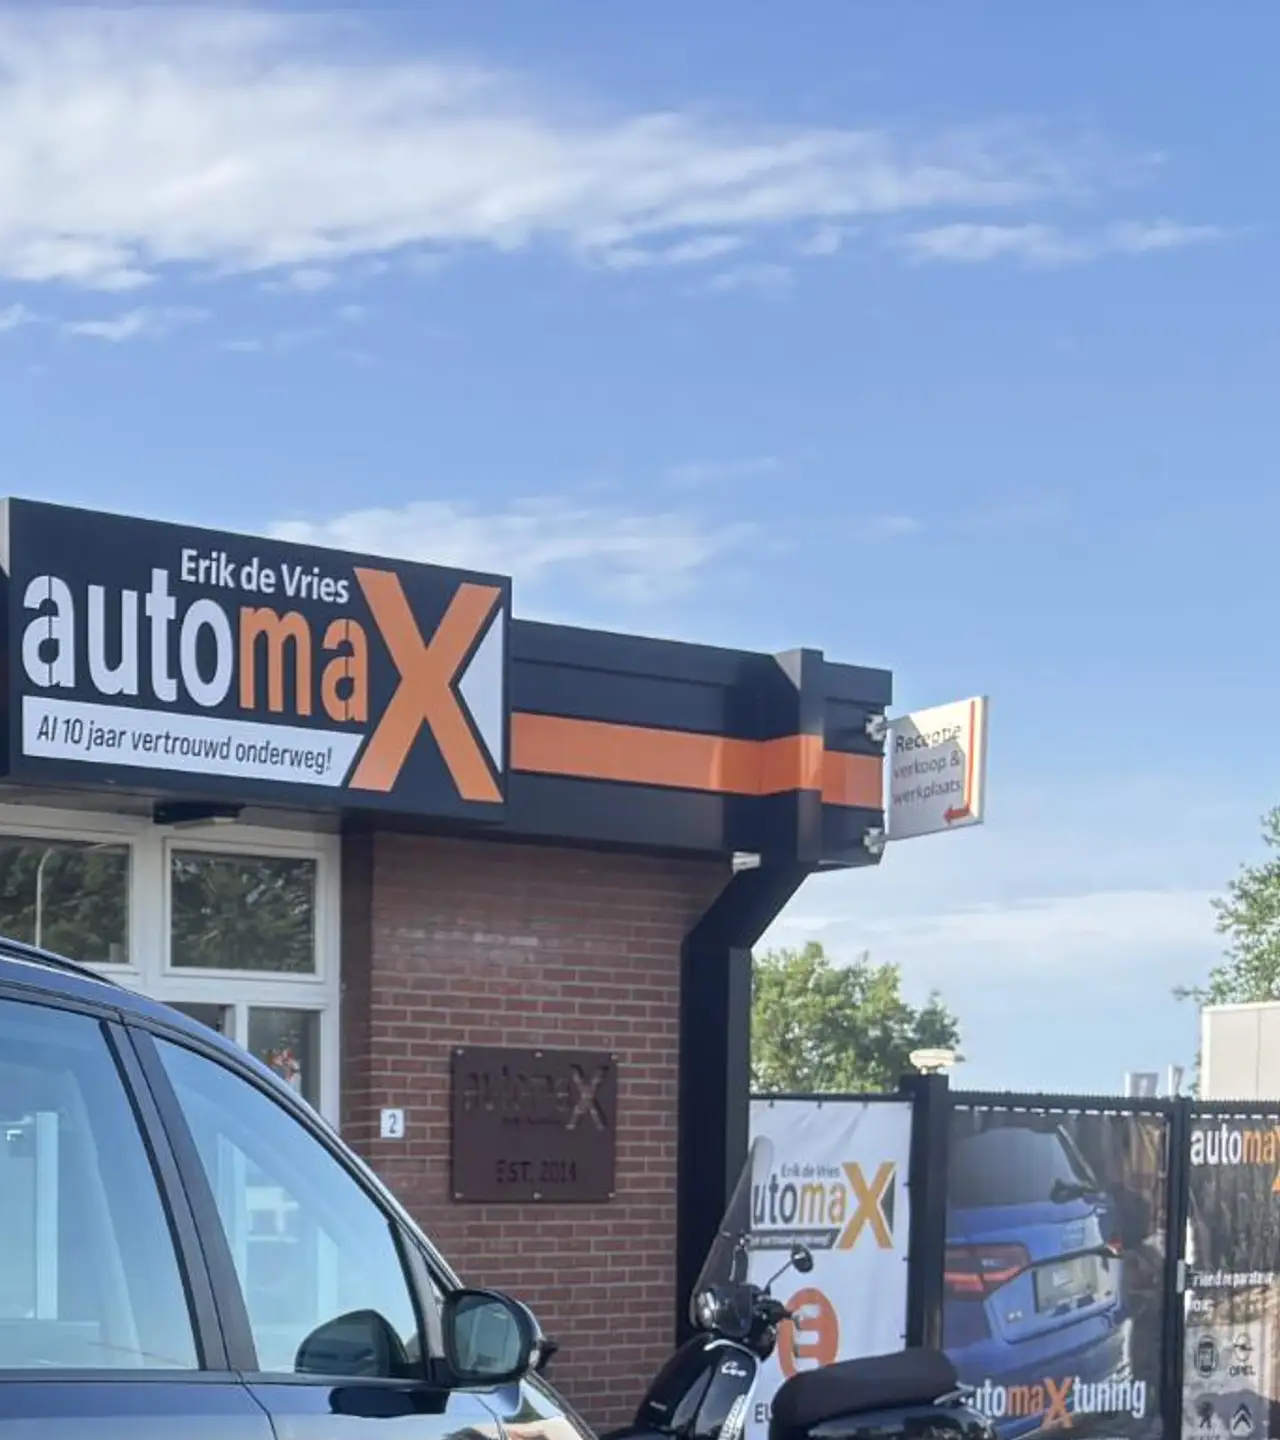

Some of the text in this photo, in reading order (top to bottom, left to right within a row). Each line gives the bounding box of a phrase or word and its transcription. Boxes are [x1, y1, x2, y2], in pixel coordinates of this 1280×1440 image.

[180, 548, 349, 604] Erik de Vries
[22, 566, 503, 802] automaX
[37, 714, 333, 775] Al 10 jaar vertrouwd onderweg!
[893, 750, 961, 780] verkoop &
[892, 779, 962, 807] werkplaats
[387, 1112, 399, 1135] 2
[753, 1161, 896, 1250] utomaX
